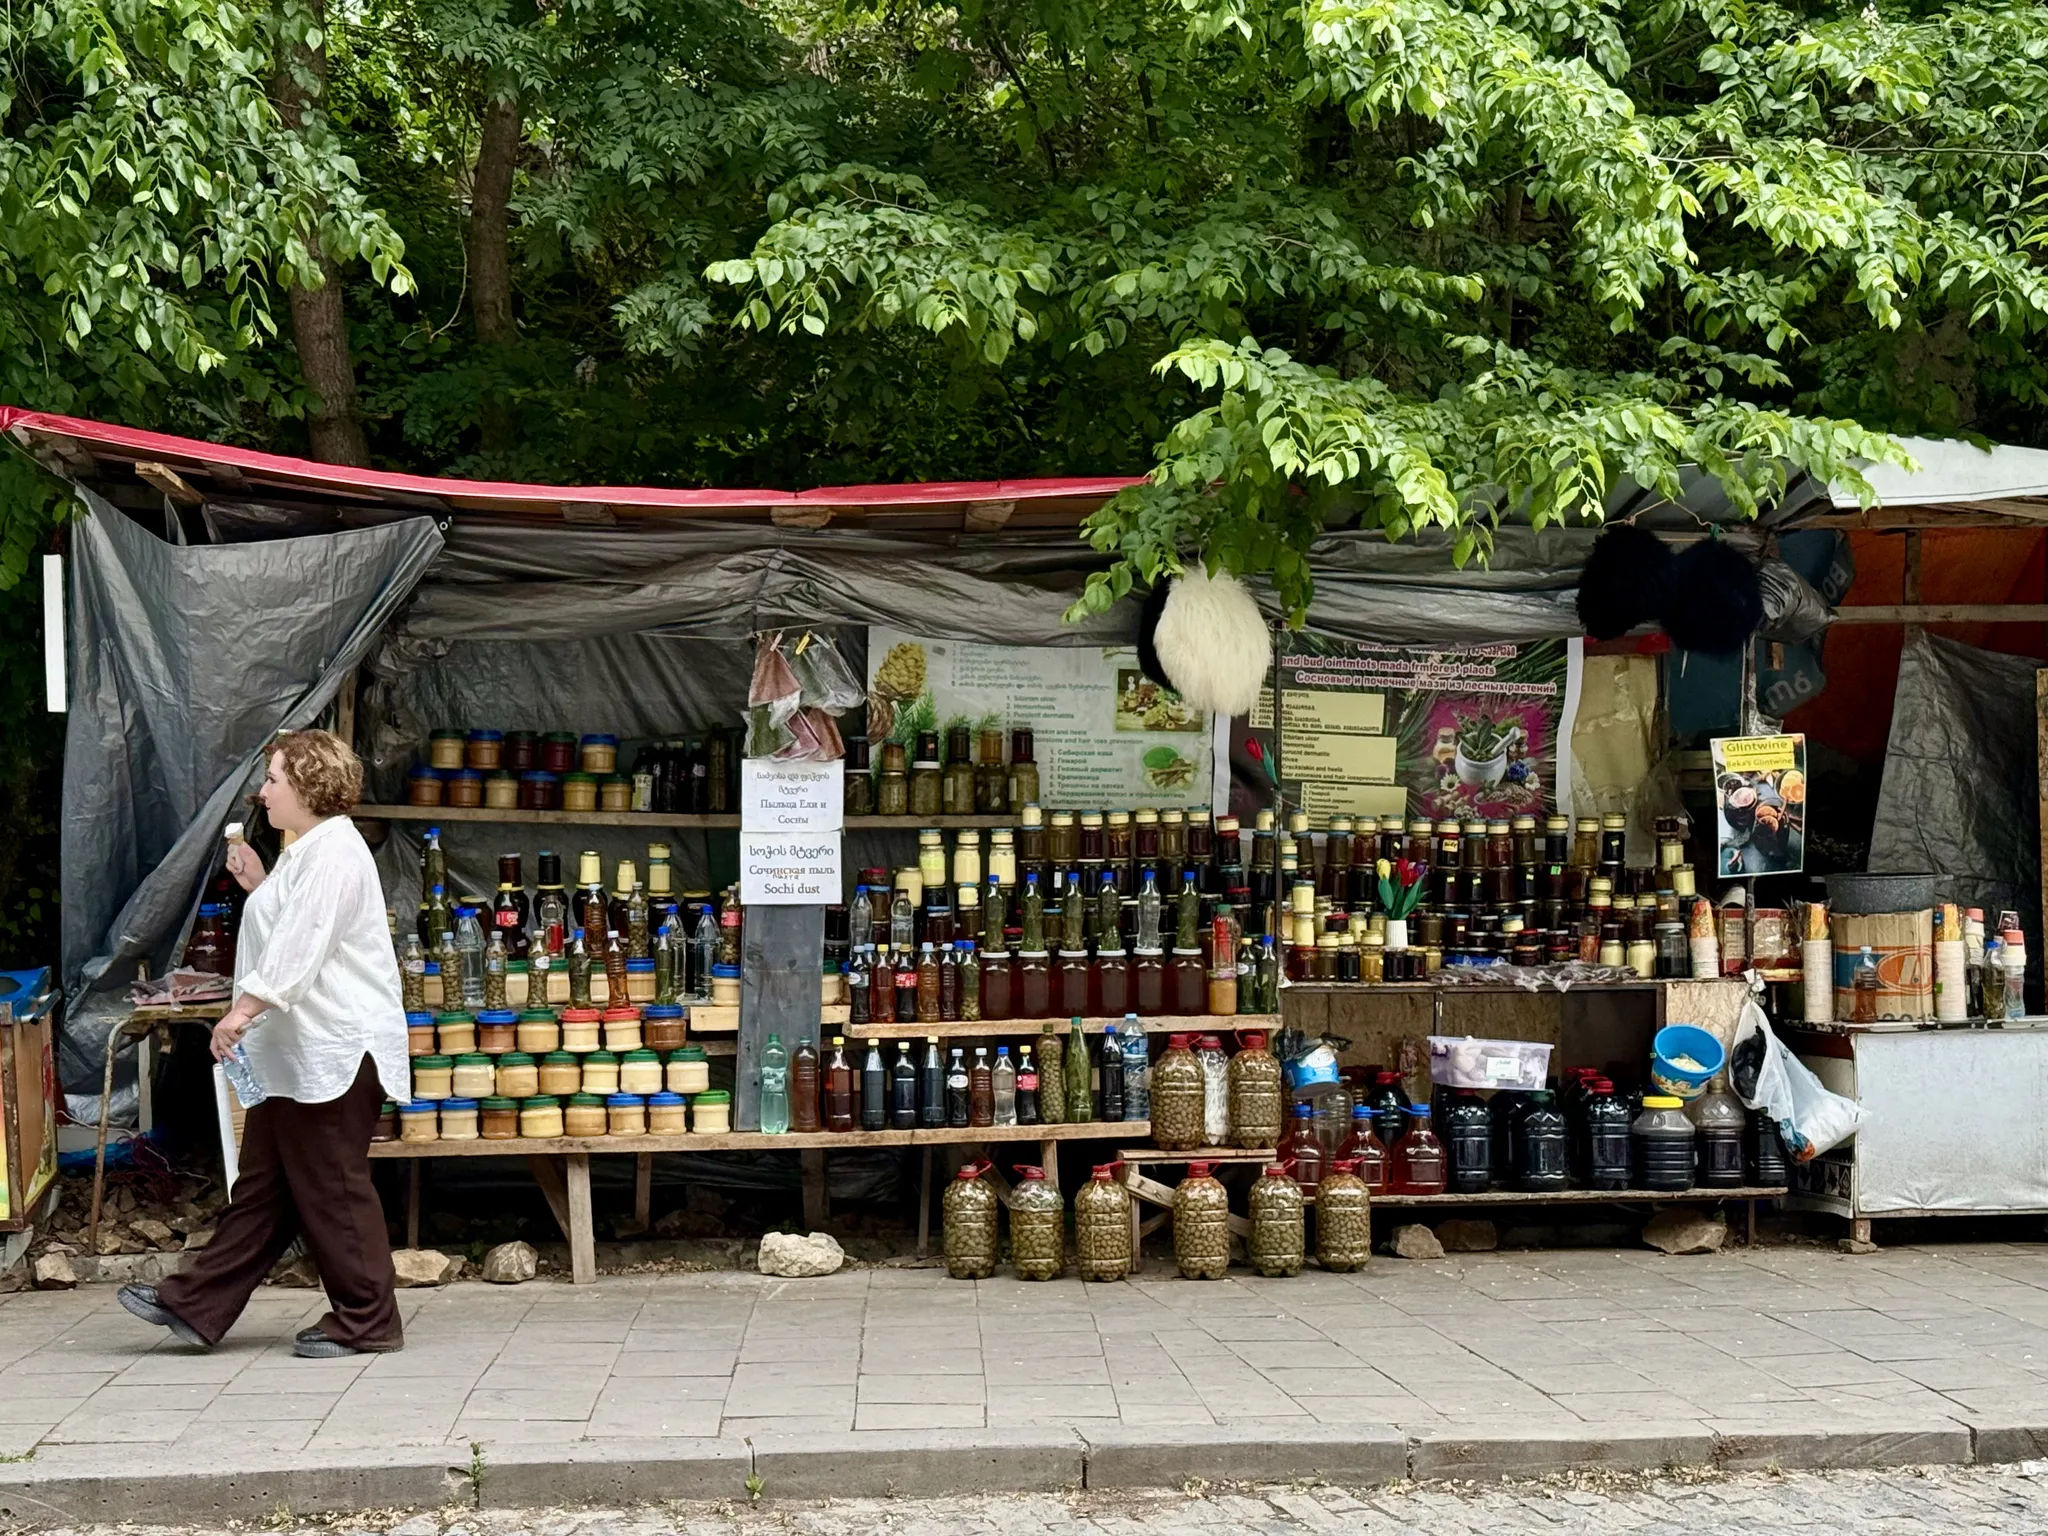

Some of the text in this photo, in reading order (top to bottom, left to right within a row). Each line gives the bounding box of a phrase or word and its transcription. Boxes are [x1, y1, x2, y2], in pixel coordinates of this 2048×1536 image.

[1304, 656, 1323, 667] bud
[1296, 671, 1556, 695] Сосновые и почечные мази из лесных растений
[1726, 740, 1788, 752] Glintwine
[760, 800, 797, 810] Пыльца
[799, 800, 817, 809] Ели
[778, 815, 808, 824] Сосны
[749, 865, 835, 875] Сочинская пыль
[764, 883, 820, 894] Sochi dust
